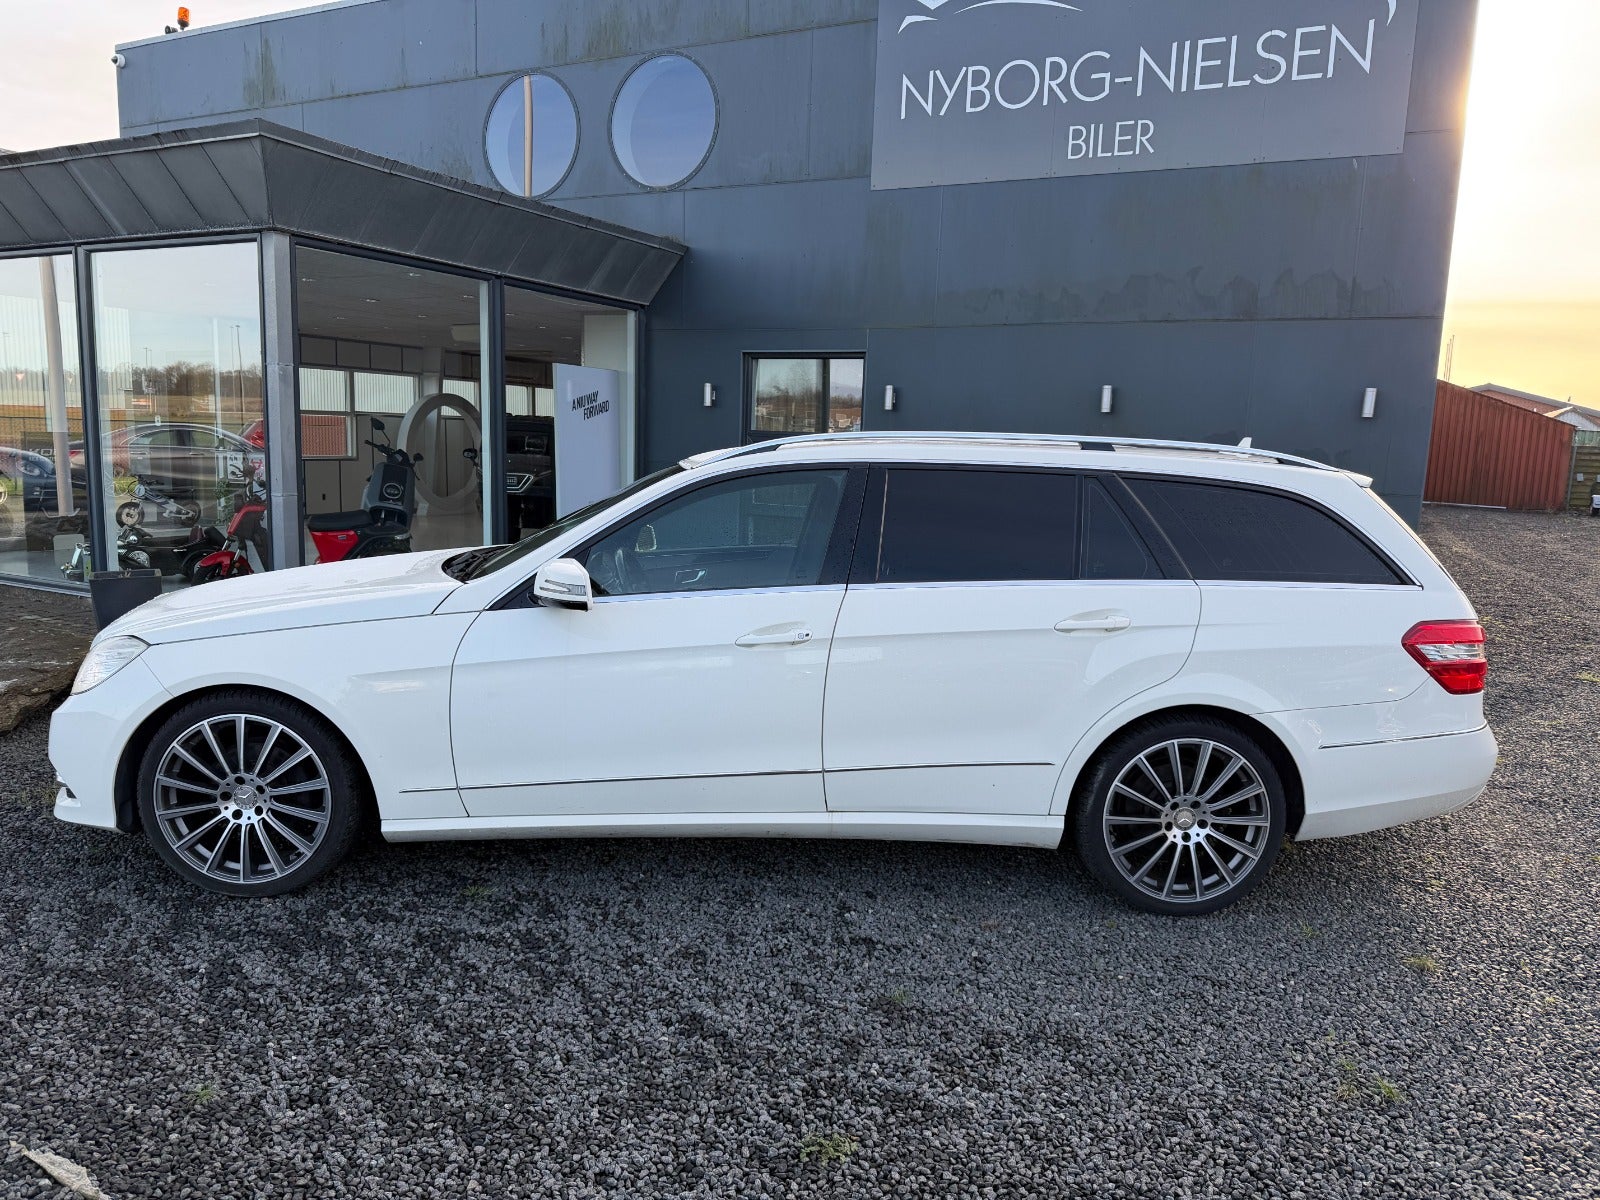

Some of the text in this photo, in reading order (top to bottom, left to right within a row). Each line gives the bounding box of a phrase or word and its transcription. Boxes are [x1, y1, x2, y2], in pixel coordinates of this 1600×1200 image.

[900, 18, 1376, 120] NYBORG-NIELSEN
[1066, 119, 1155, 160] BILER
[571, 399, 577, 412] A
[586, 390, 599, 406] WAY
[583, 400, 610, 421] FORWARD
